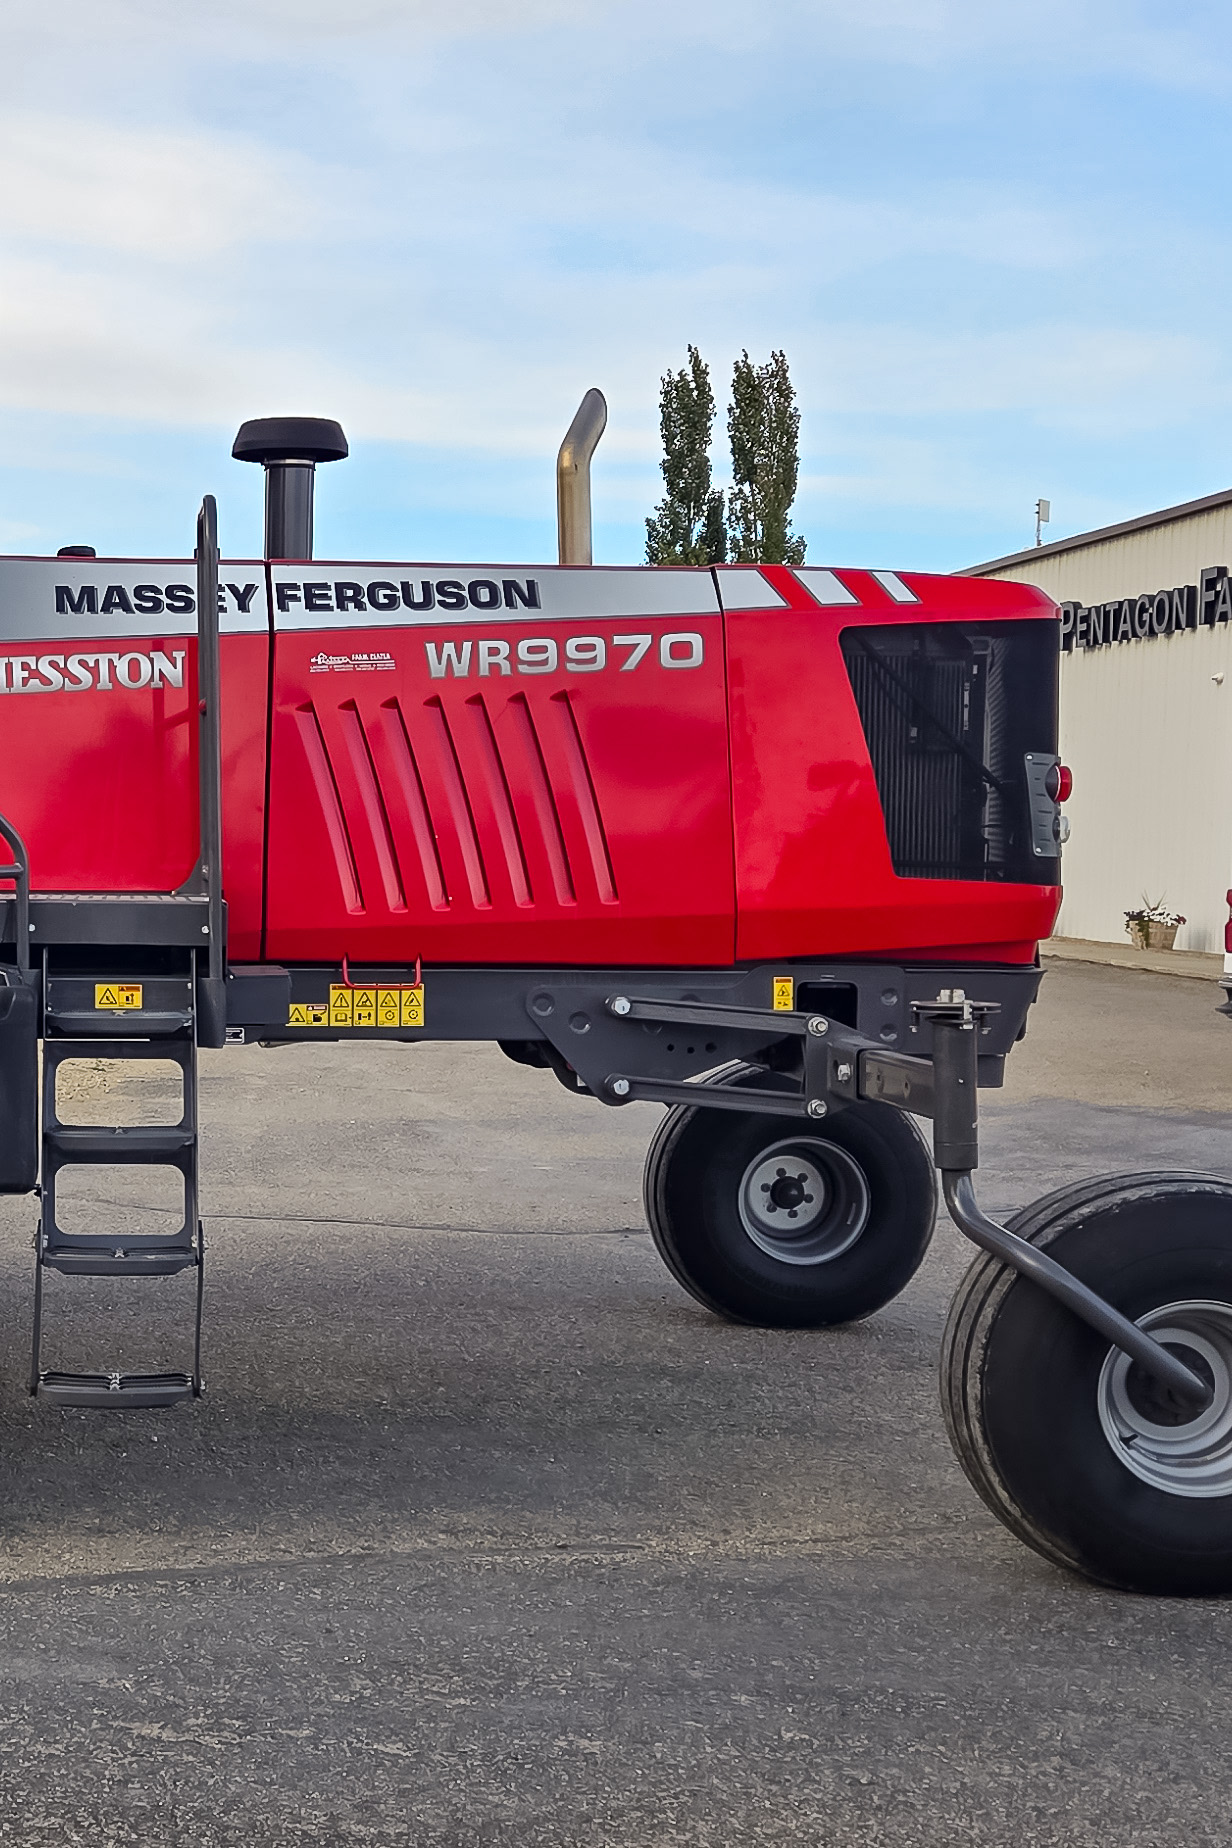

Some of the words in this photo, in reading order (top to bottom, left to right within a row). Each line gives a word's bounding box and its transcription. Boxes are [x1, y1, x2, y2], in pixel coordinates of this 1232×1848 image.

[275, 579, 542, 613] FERGUSON
[1060, 585, 1197, 651] PENTAGON
[424, 631, 705, 680] WR9970
